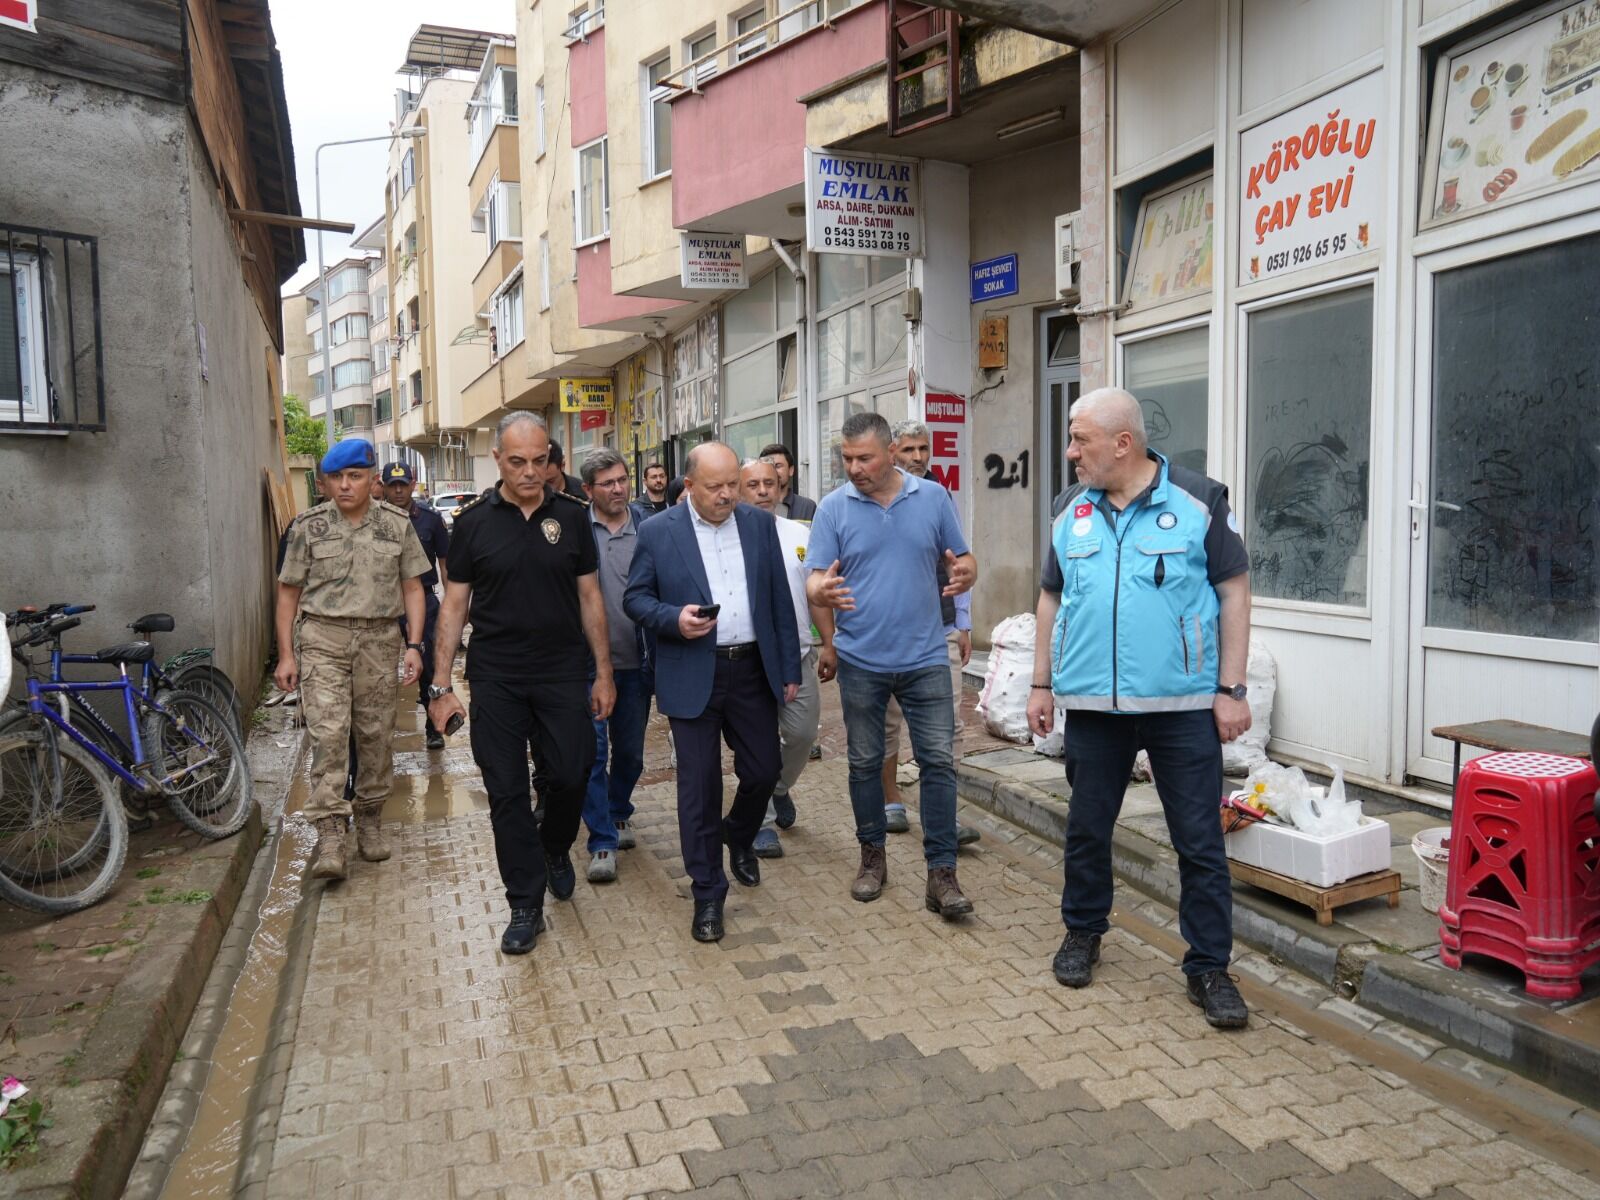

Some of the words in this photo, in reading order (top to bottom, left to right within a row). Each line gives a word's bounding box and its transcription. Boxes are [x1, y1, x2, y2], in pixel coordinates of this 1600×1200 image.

[1246, 108, 1377, 199] KÖROĞLU
[819, 158, 910, 182] MUŞTULAR
[822, 180, 910, 203] EMLAK
[816, 199, 844, 213] ARSA,
[877, 204, 915, 217] DÜKKAN
[1255, 193, 1302, 246] ÇAY
[1307, 165, 1355, 219] EVİ
[824, 226, 831, 236] 0
[834, 227, 855, 237] 543
[858, 229, 877, 239] 591
[880, 231, 894, 240] 73
[897, 232, 910, 241] 10
[688, 239, 741, 250] MUŞTULAR
[824, 237, 832, 246] 0
[834, 238, 855, 248] 543
[858, 239, 878, 249] 533
[880, 241, 894, 250] 08
[897, 242, 910, 251] 75
[1266, 250, 1290, 273] 0531
[1293, 243, 1312, 266] 926
[1315, 238, 1330, 258] 65
[1332, 232, 1348, 253] 95
[698, 250, 731, 260] EMLAK
[974, 267, 990, 281] HAFIZ
[991, 261, 1013, 279] ŞEVKET
[983, 279, 1005, 293] SOKAK
[926, 401, 964, 419] MUŞTULAR
